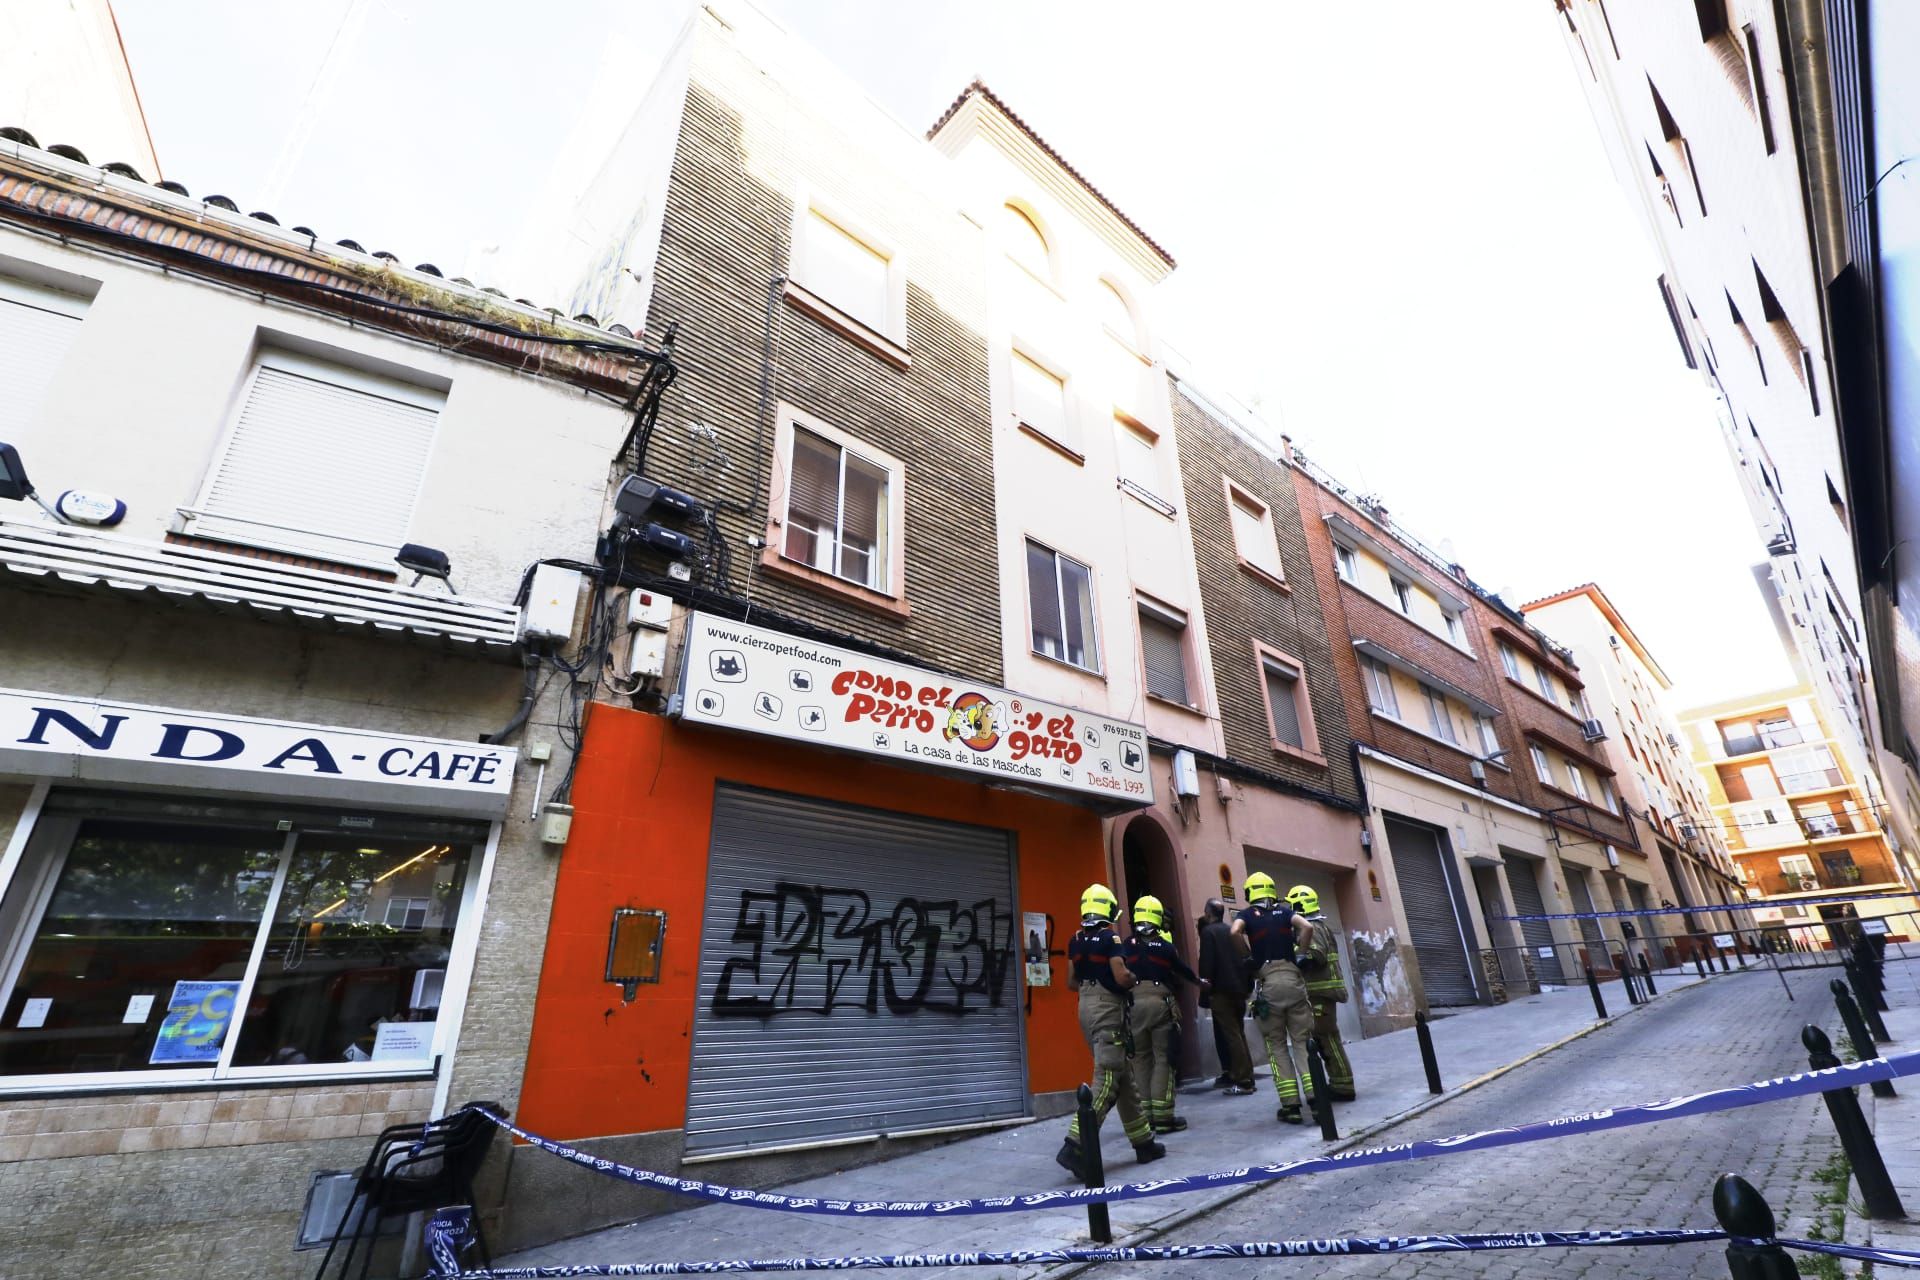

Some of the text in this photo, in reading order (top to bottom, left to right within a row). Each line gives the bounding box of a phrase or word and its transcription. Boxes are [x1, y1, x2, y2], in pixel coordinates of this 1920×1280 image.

[707, 627, 842, 667] www.cierzopetfood.com
[845, 693, 934, 733] Perro
[1047, 714, 1074, 739] el
[1103, 724, 1115, 733] 976
[1116, 727, 1128, 736] 937
[904, 741, 918, 754] La
[922, 746, 951, 760] casa
[955, 751, 968, 763] de
[973, 753, 989, 767] las
[1088, 772, 1144, 794] Desde 1993
[1548, 1112, 1590, 1127] POLICIA
[1313, 1239, 1349, 1253] NO
[1484, 1238, 1525, 1247] POLICIA
[893, 1253, 979, 1267] NO PASAR
